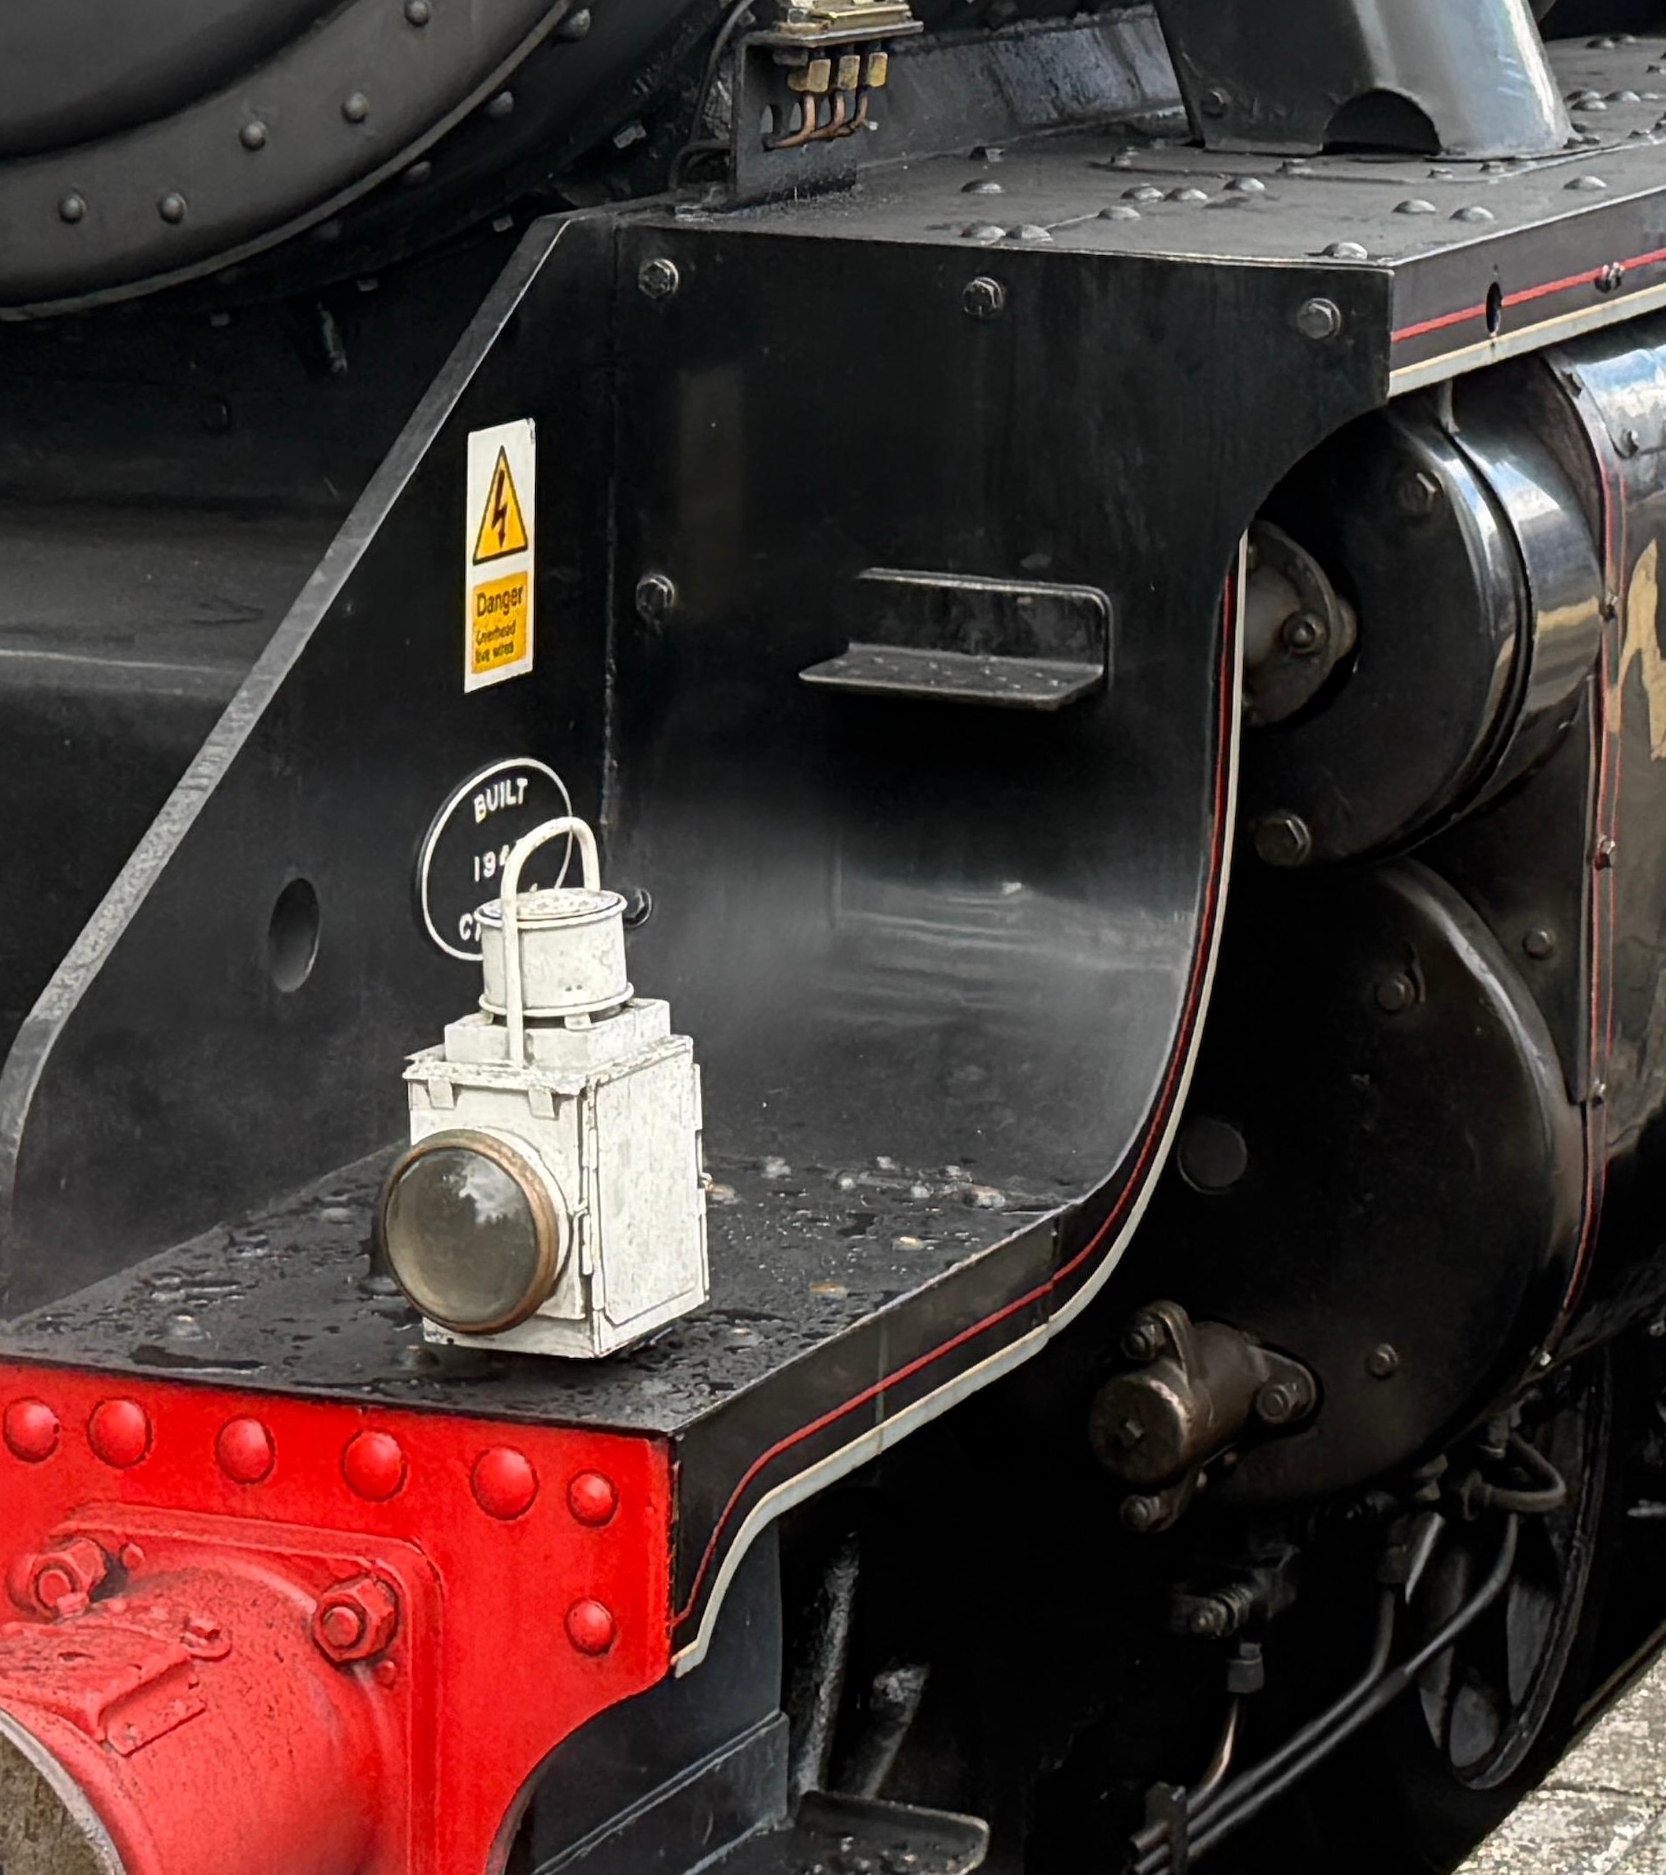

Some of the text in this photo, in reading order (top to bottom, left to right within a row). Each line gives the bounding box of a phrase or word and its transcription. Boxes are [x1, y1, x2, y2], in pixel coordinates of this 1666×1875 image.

[476, 585, 523, 618] Danger
[473, 777, 529, 824] BUILT
[474, 843, 510, 883] 19
